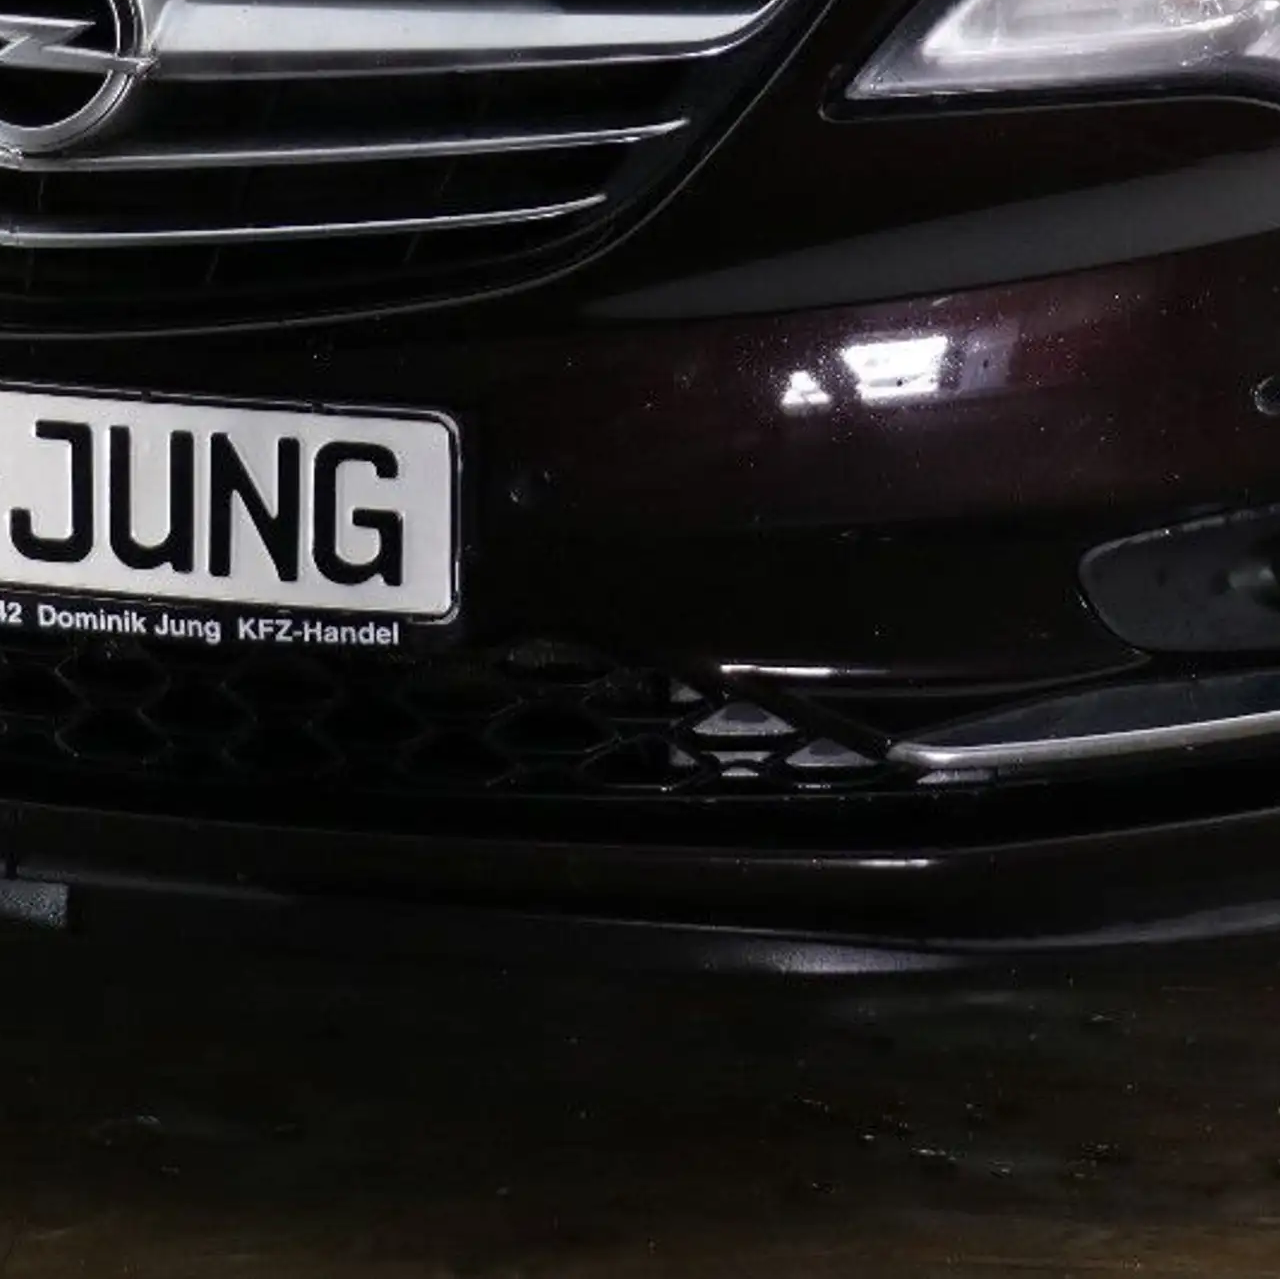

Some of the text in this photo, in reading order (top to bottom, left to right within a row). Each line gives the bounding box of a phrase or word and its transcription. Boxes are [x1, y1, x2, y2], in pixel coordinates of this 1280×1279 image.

[38, 605, 146, 633] Dominik
[155, 614, 221, 644] Jung
[238, 618, 400, 645] KFZ-Handel
